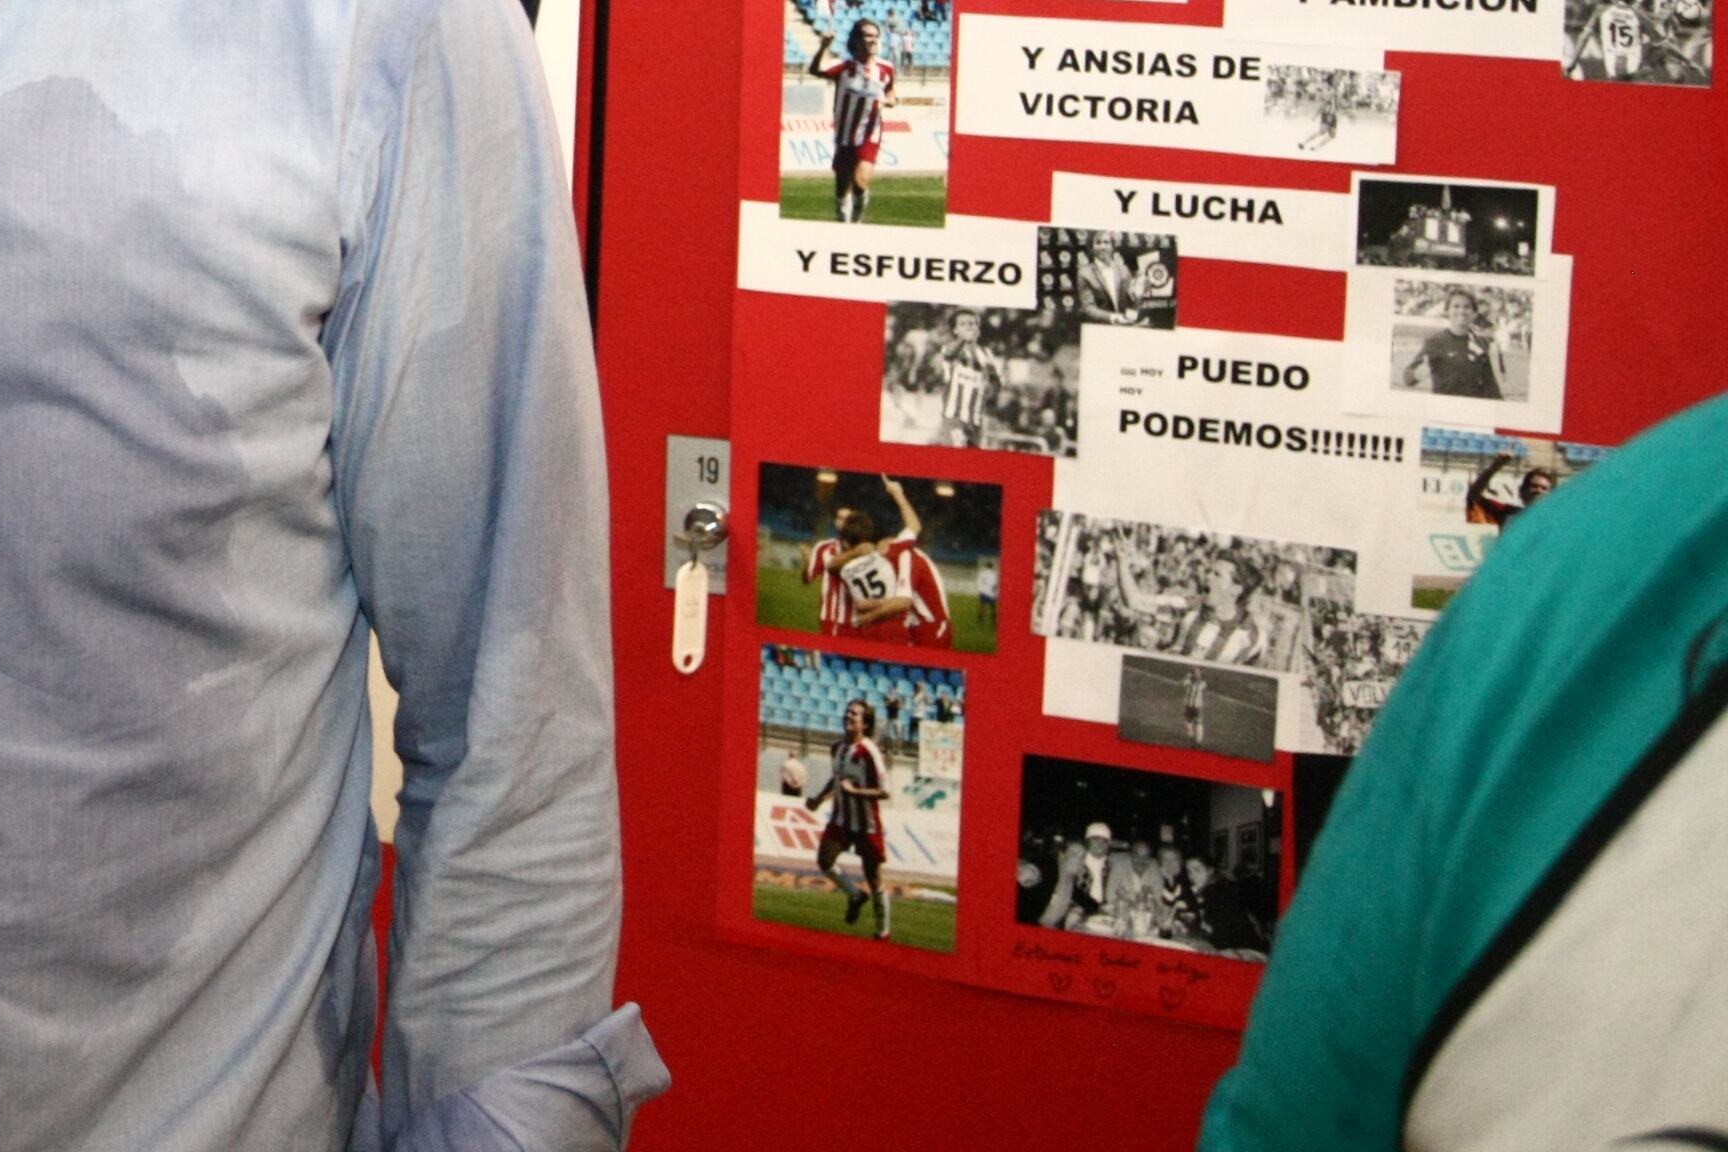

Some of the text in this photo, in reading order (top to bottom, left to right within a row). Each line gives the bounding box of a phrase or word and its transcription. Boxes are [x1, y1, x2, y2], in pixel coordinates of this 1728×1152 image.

[1608, 11, 1634, 48] 15
[1021, 46, 1261, 81] Y ANSIAS DE
[1019, 91, 1200, 125] VICTORIA
[1114, 189, 1284, 226] Y LUCHA
[796, 249, 1023, 286] Y ESFUERZO
[1176, 354, 1310, 391] PUEDO
[696, 455, 720, 485] 19
[851, 569, 887, 599] 15
